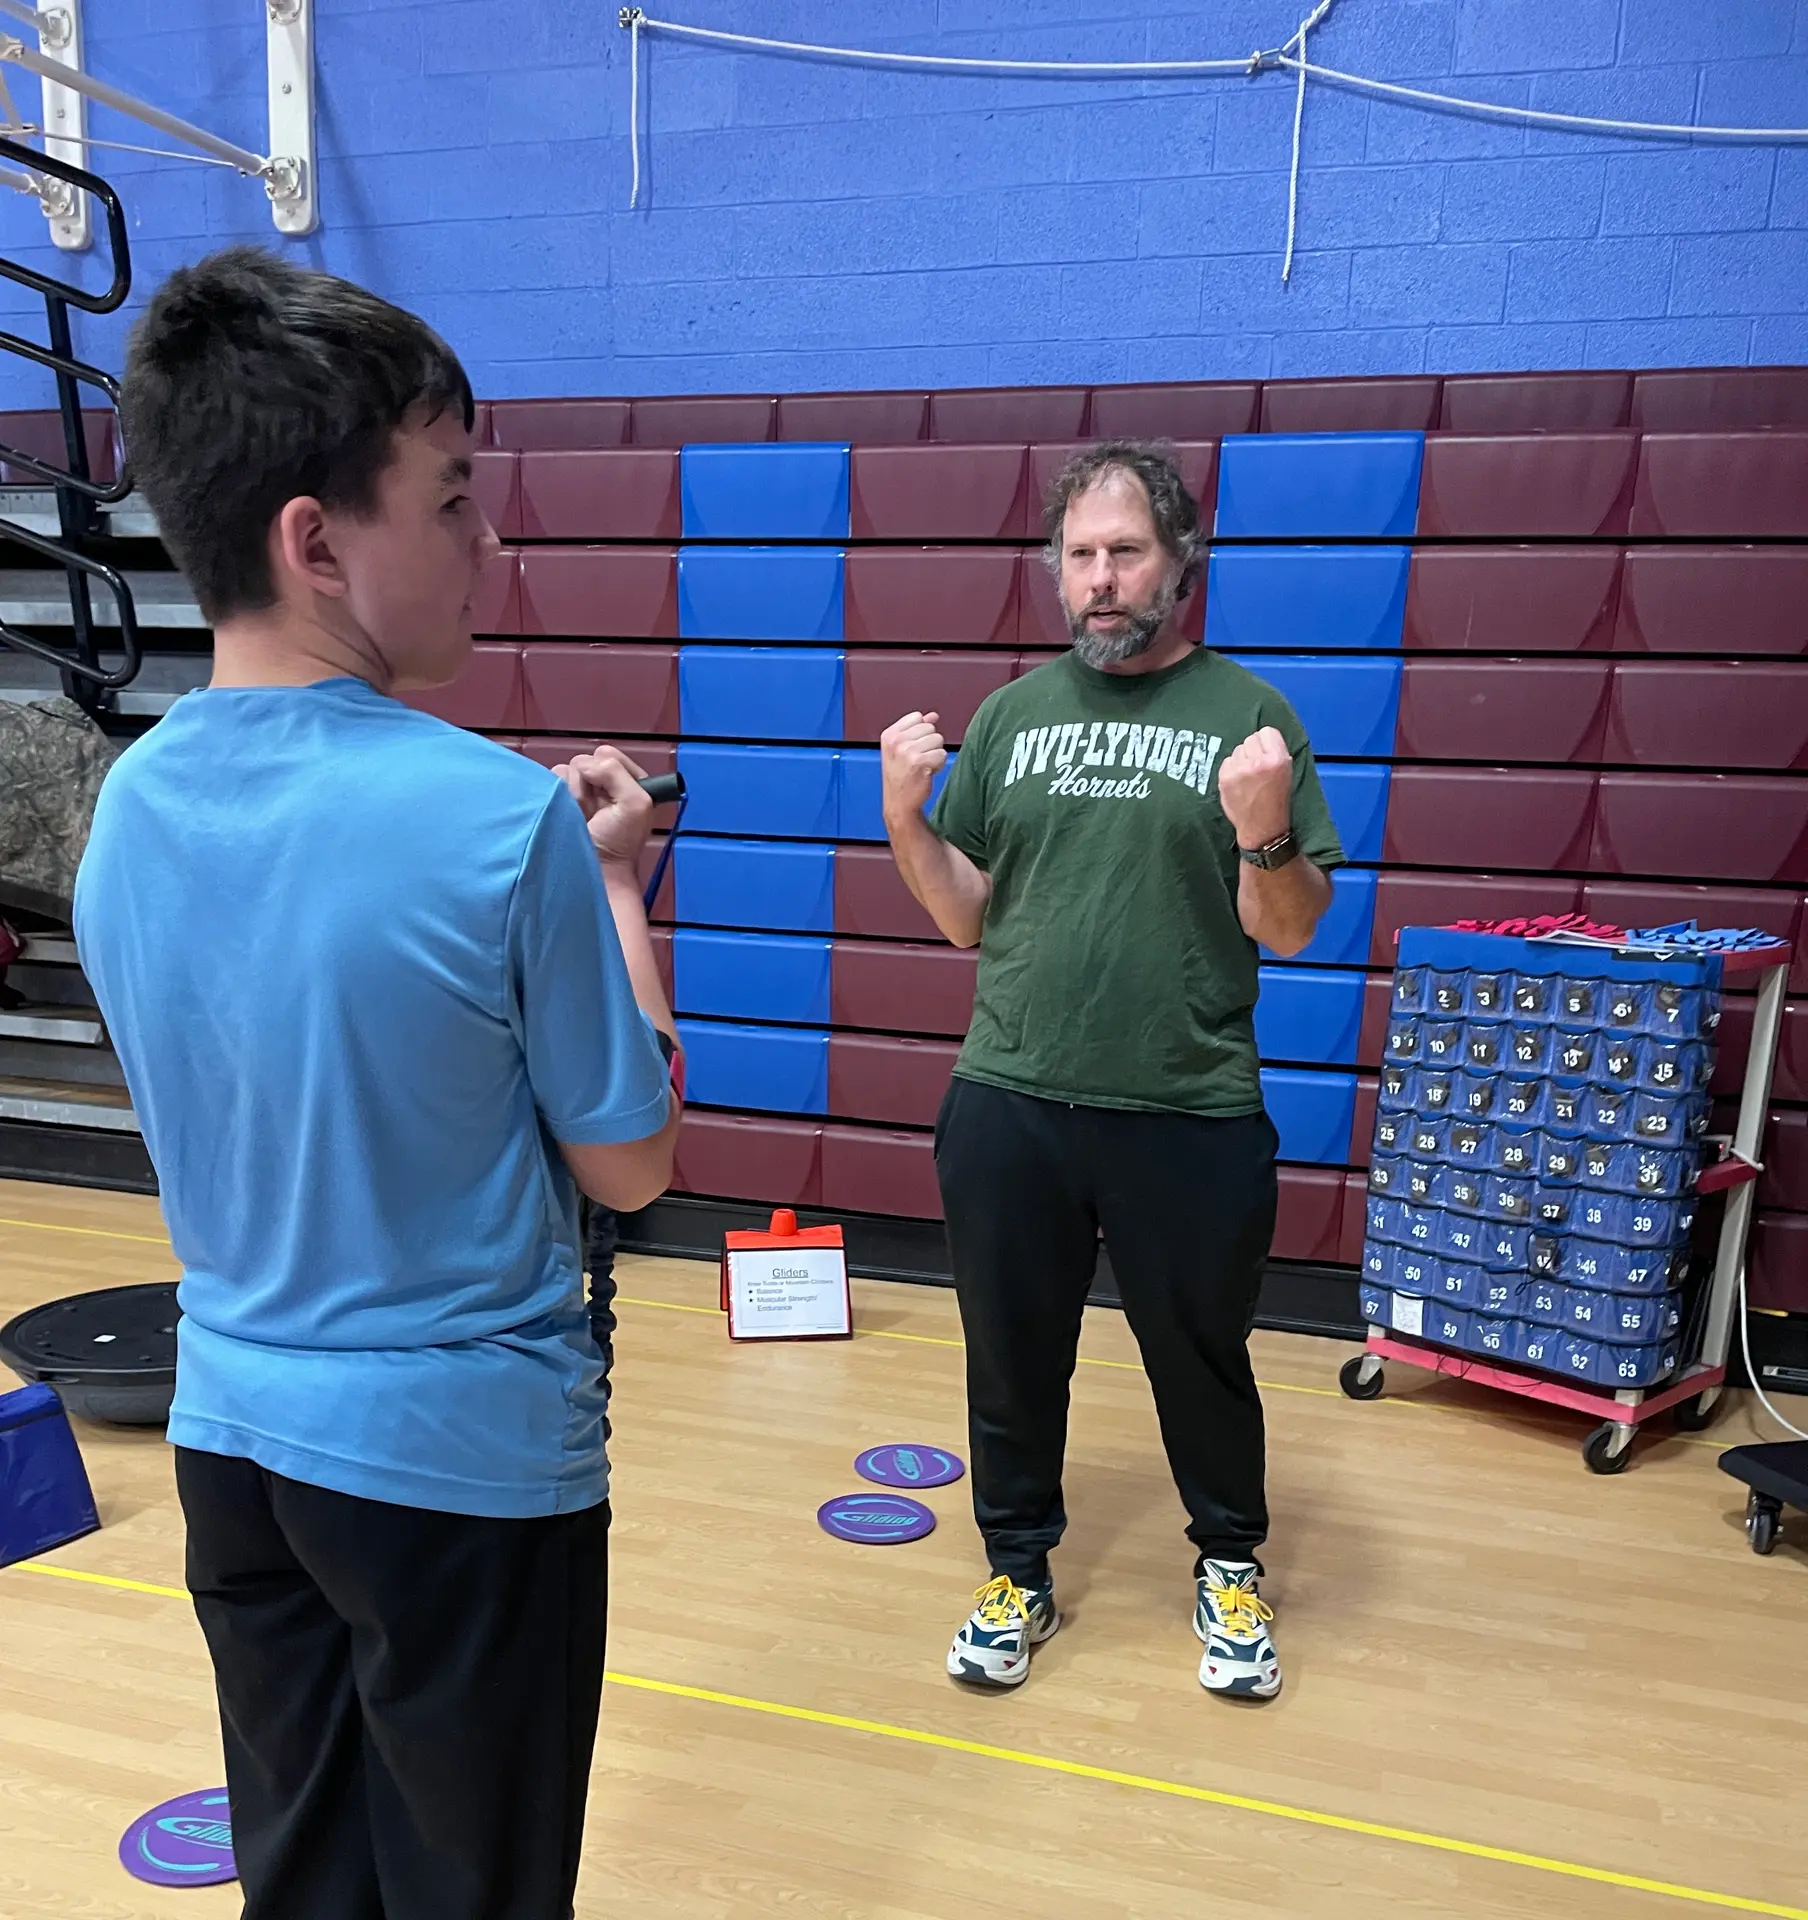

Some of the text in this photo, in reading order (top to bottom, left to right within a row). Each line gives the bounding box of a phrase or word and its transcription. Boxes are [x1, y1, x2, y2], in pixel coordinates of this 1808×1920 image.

[1004, 721, 1223, 796] NVU-LYNDON
[1047, 763, 1152, 800] Hornets
[1398, 986, 1405, 999] 1
[1438, 990, 1450, 1004] 2
[1479, 992, 1490, 1006] 3
[1521, 996, 1534, 1009] 4
[1569, 998, 1580, 1012] 5
[1615, 1003, 1627, 1018] 6
[1667, 1009, 1679, 1023] 7
[1392, 1036, 1401, 1049] 9
[1430, 1040, 1445, 1053] 10
[1472, 1044, 1486, 1058] 11
[1516, 1047, 1532, 1060] 12
[1563, 1050, 1579, 1067] 13
[1656, 1063, 1674, 1079] 15
[1387, 1082, 1667, 1131] 17 18 19 20 21 22 23
[1380, 1127, 1658, 1185] 25 26 27 28 29 30 31
[1373, 1170, 1652, 1231] 33 34 35 36 37 38 39
[772, 1268, 809, 1279] Gliders
[1411, 1224, 1428, 1238] 42
[1454, 1232, 1471, 1248] 43
[1496, 1241, 1512, 1256] 44
[1581, 1259, 1597, 1275] 46
[1628, 1268, 1648, 1283] 47
[1369, 1257, 1641, 1329] 49 50 51 52 53 54 55
[1365, 1300, 1379, 1315] 57
[1443, 1322, 1457, 1338] 59
[1527, 1344, 1544, 1360] 61
[1571, 1354, 1588, 1369] 62
[1618, 1363, 1637, 1378] 63
